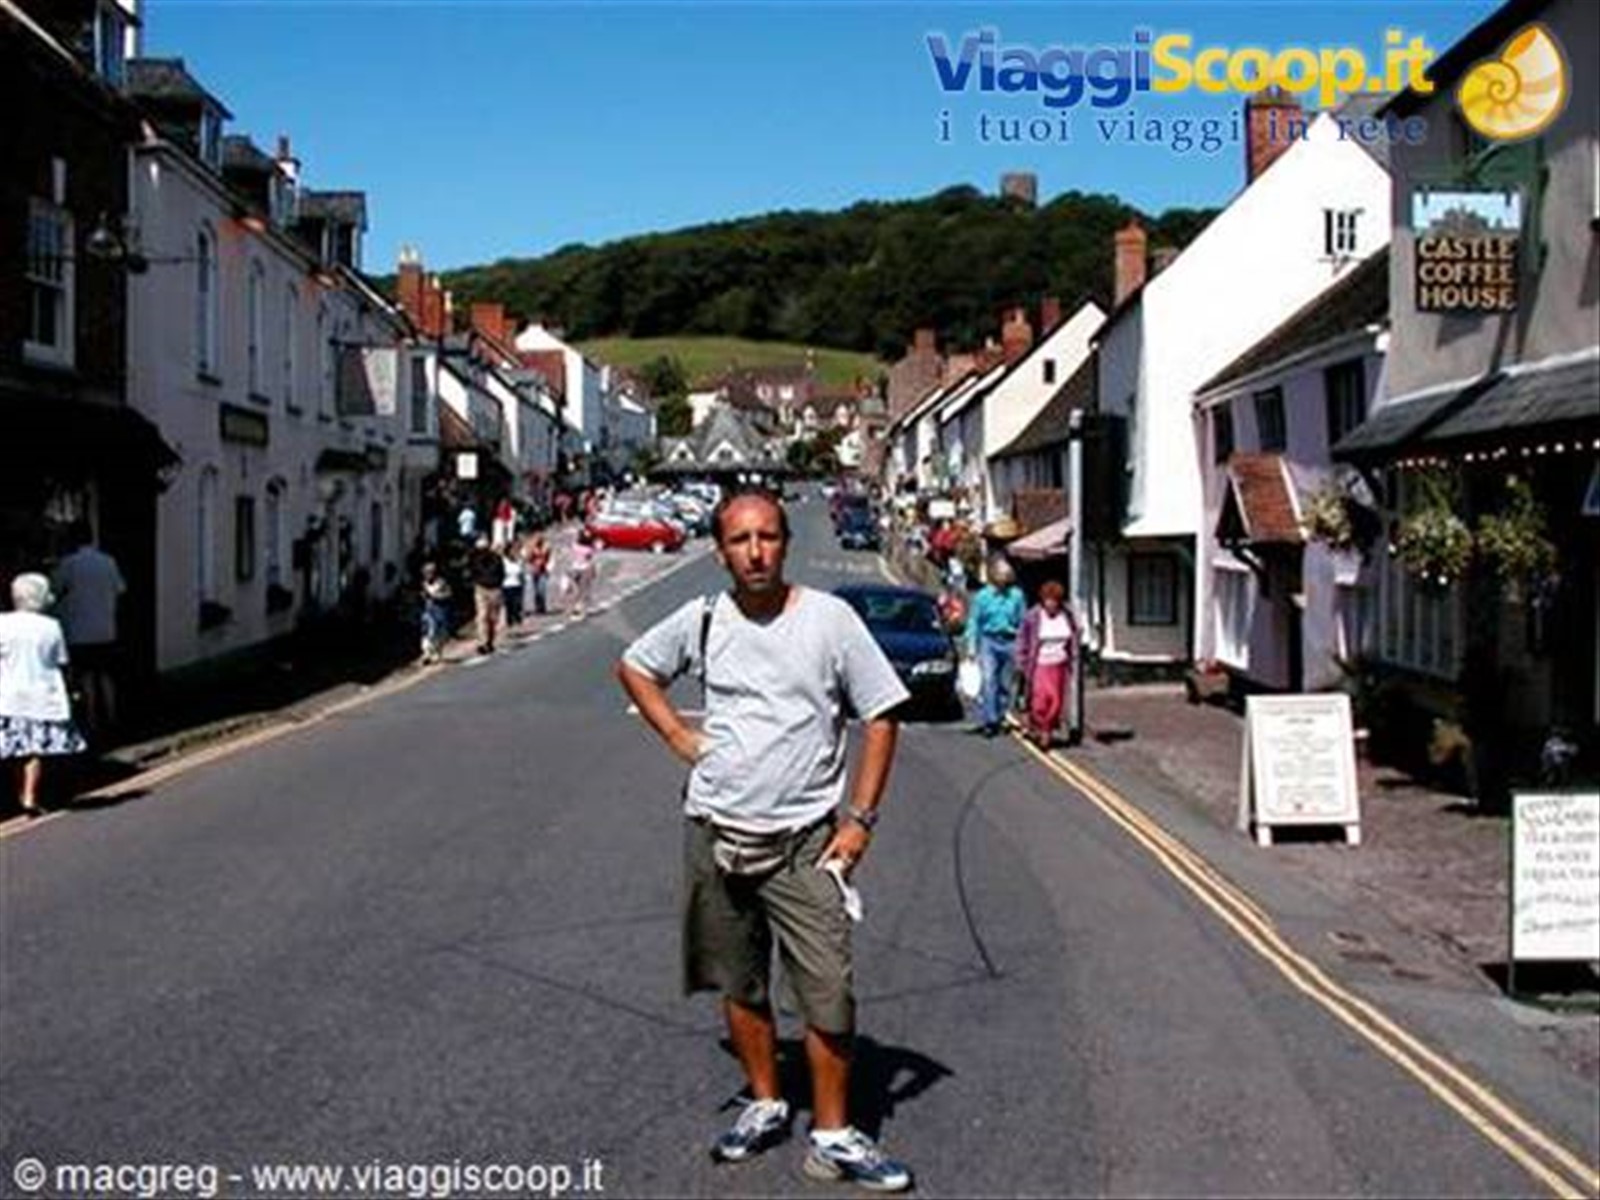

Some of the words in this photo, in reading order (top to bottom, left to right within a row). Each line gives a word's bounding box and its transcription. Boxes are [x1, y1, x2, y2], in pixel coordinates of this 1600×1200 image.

[1418, 238, 1515, 259] CASTLE
[1418, 261, 1515, 284] COFFEE
[1419, 285, 1516, 310] HOUSE
